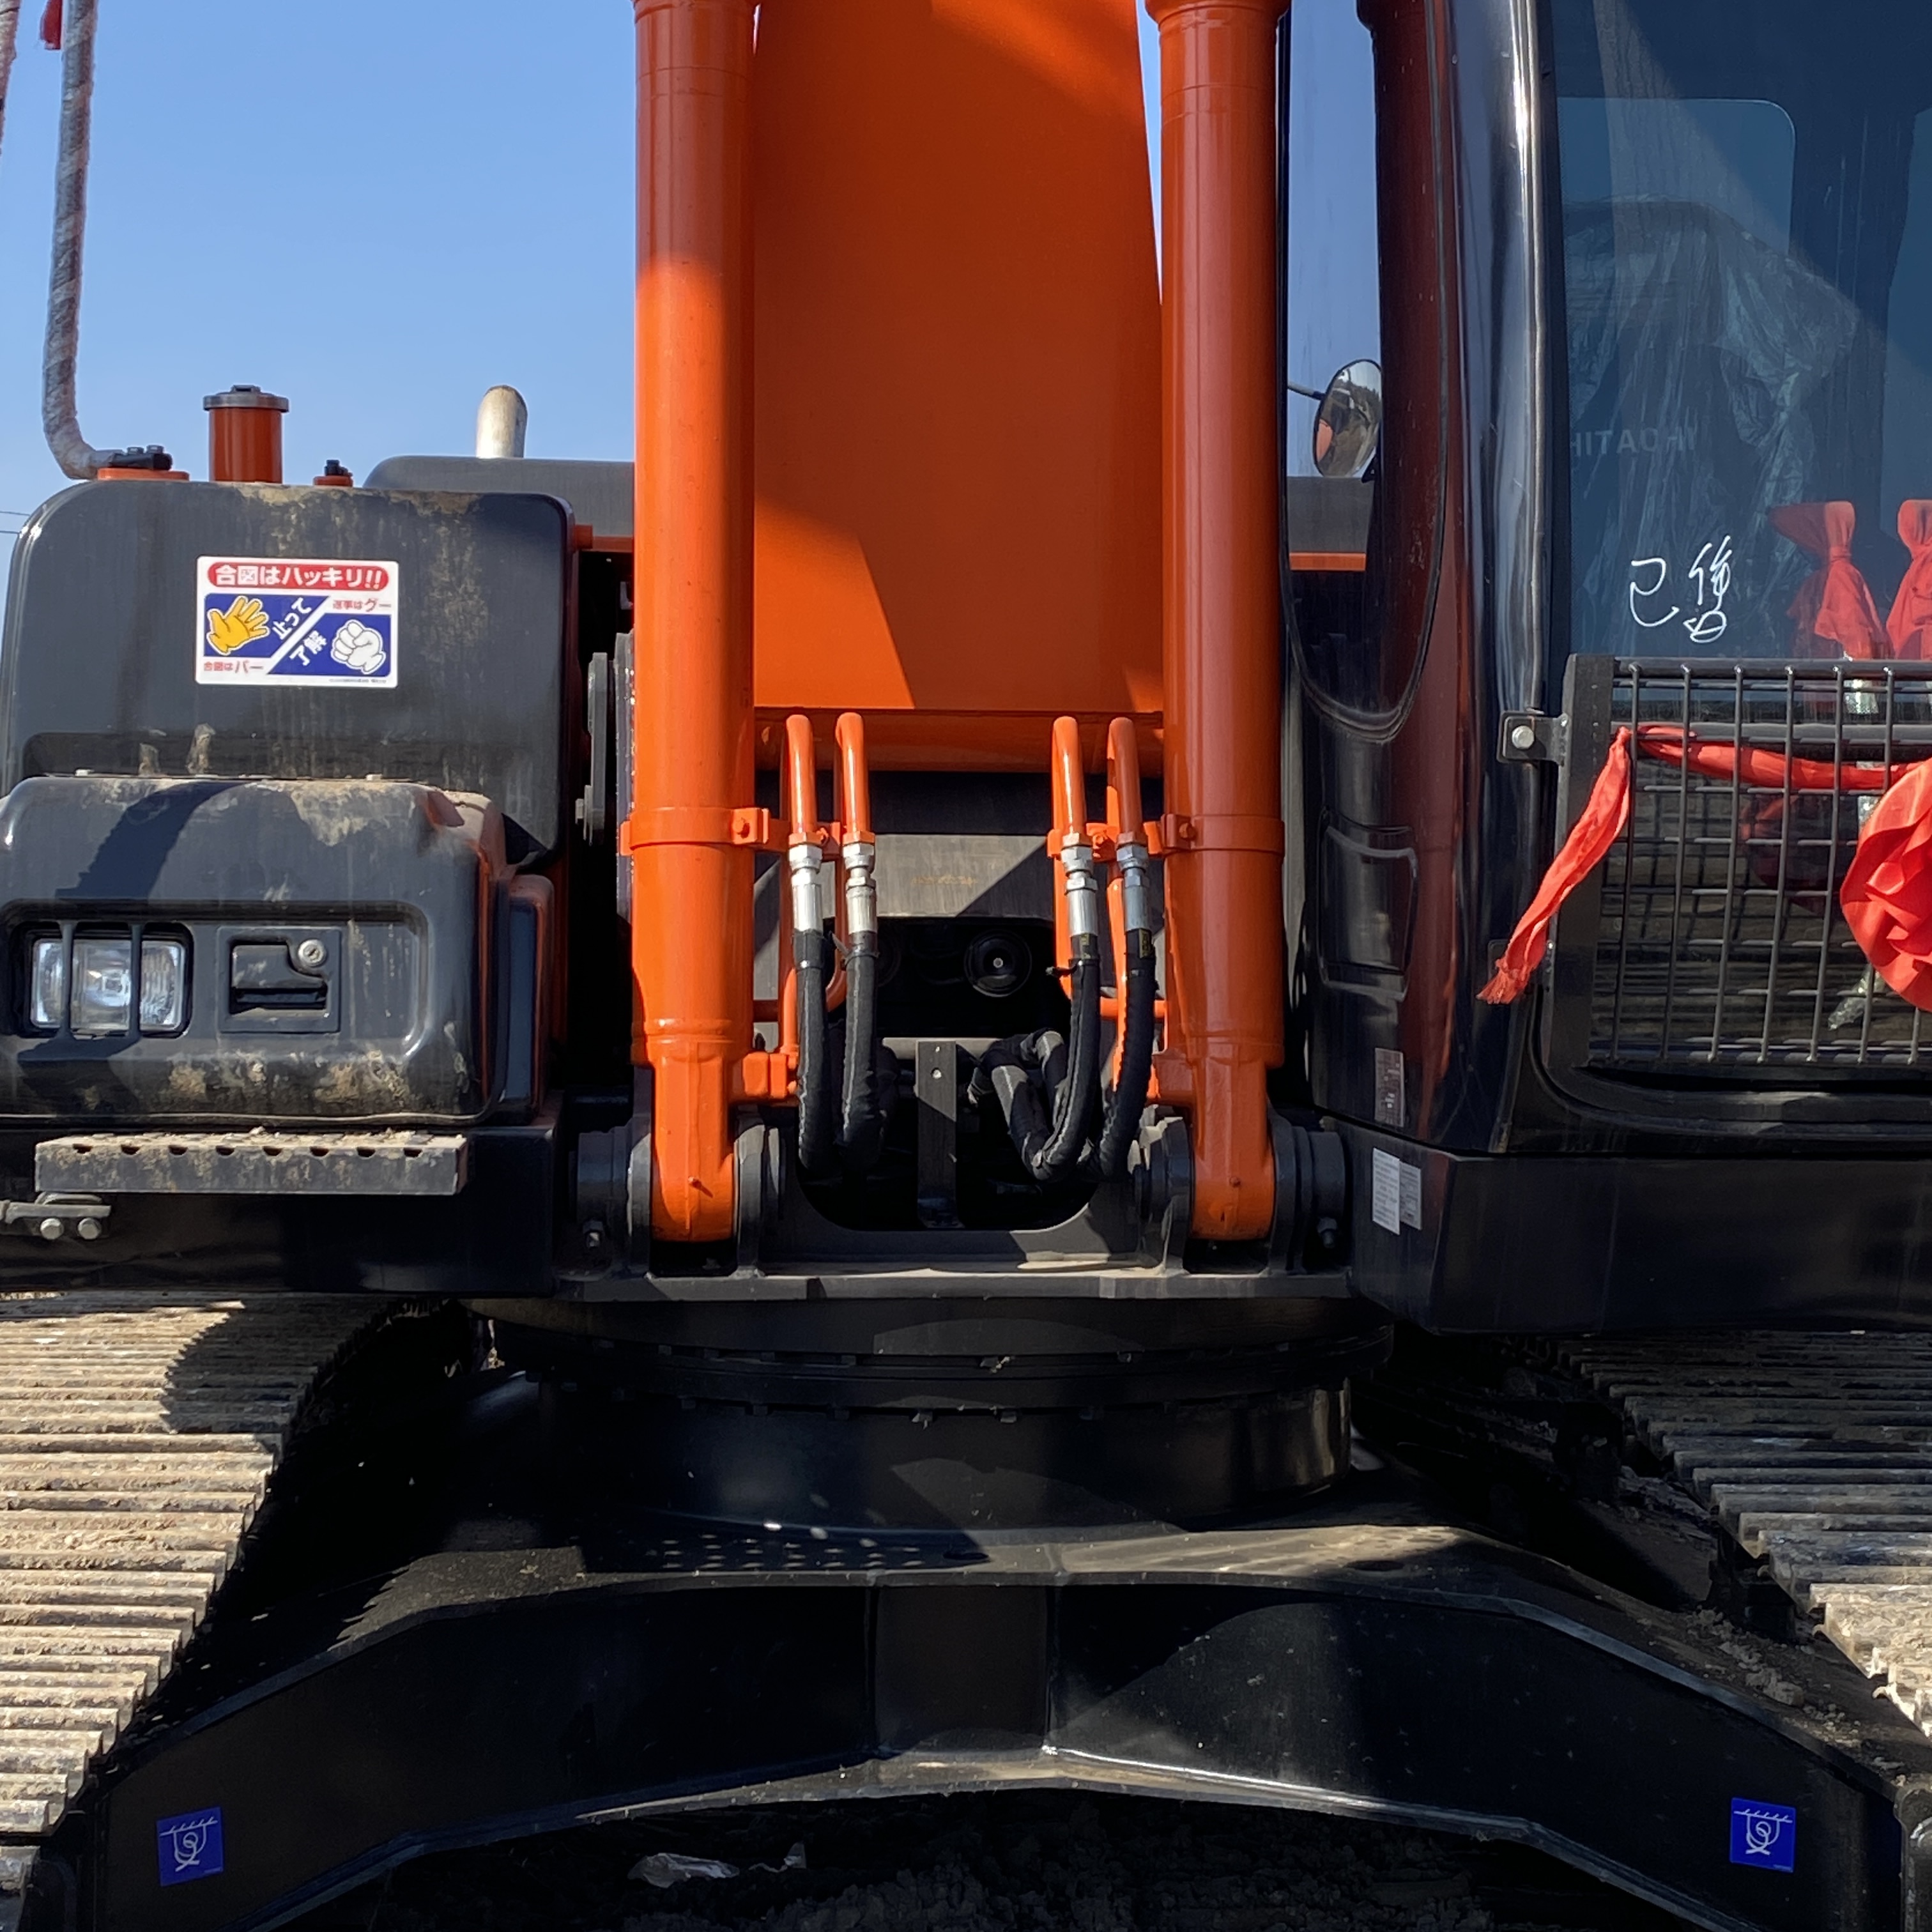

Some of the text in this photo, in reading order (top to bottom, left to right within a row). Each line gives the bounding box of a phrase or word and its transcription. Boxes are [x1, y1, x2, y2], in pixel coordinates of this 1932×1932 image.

[272, 597, 312, 640] 止って
[289, 630, 327, 666] 了解
